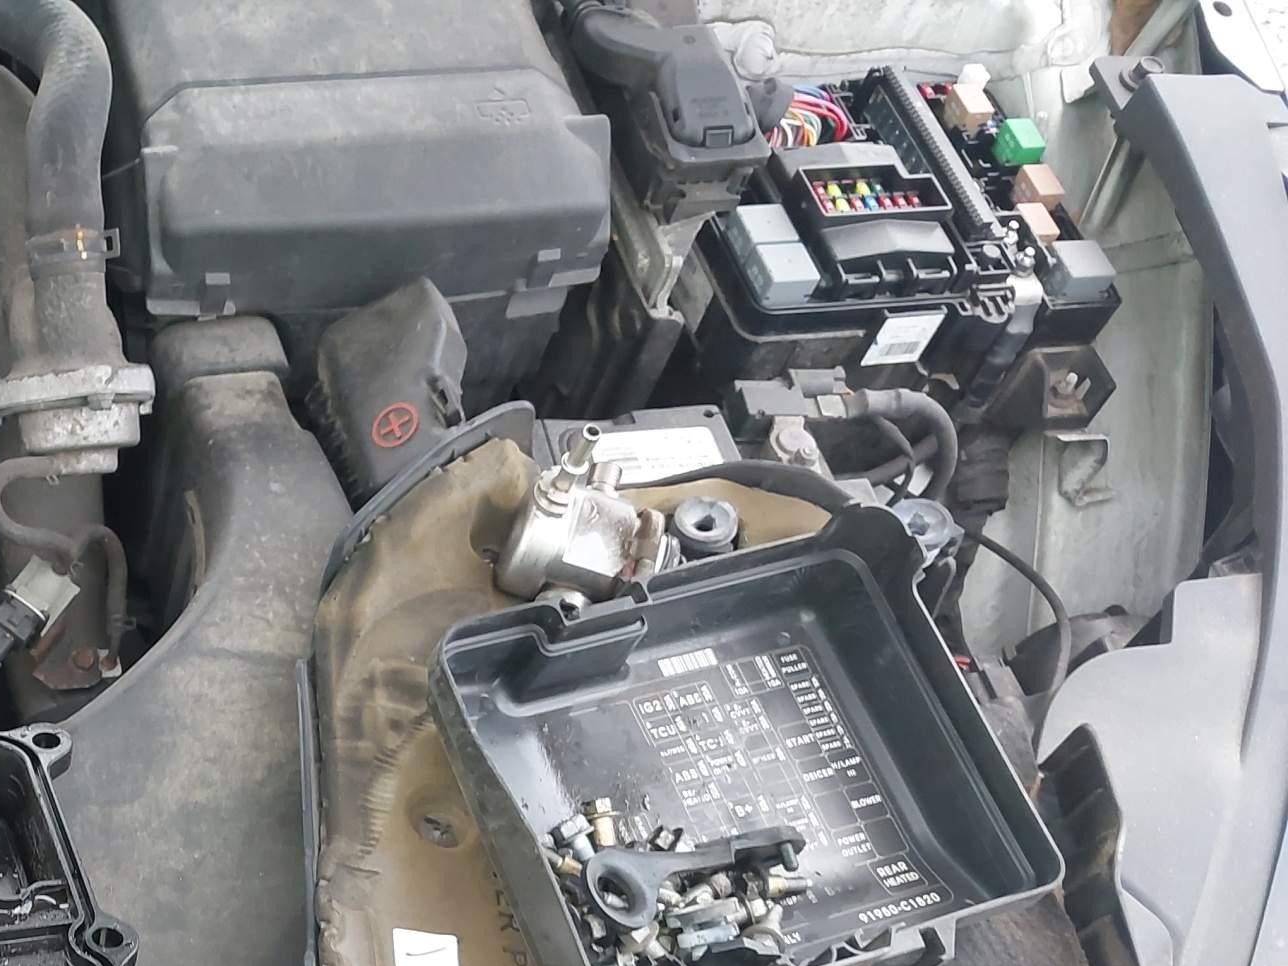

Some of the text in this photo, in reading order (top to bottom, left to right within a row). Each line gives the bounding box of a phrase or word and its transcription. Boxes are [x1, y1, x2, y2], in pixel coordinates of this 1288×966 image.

[782, 662, 808, 674] PULLER
[638, 699, 663, 715] IG2
[650, 724, 677, 740] TCU
[785, 733, 815, 749] START
[802, 767, 834, 782] DEICER
[851, 794, 882, 810] BLOWER
[837, 831, 866, 847] POWER
[841, 841, 873, 858] OUTLET
[876, 860, 909, 878] REAR
[883, 870, 920, 889] HEATED
